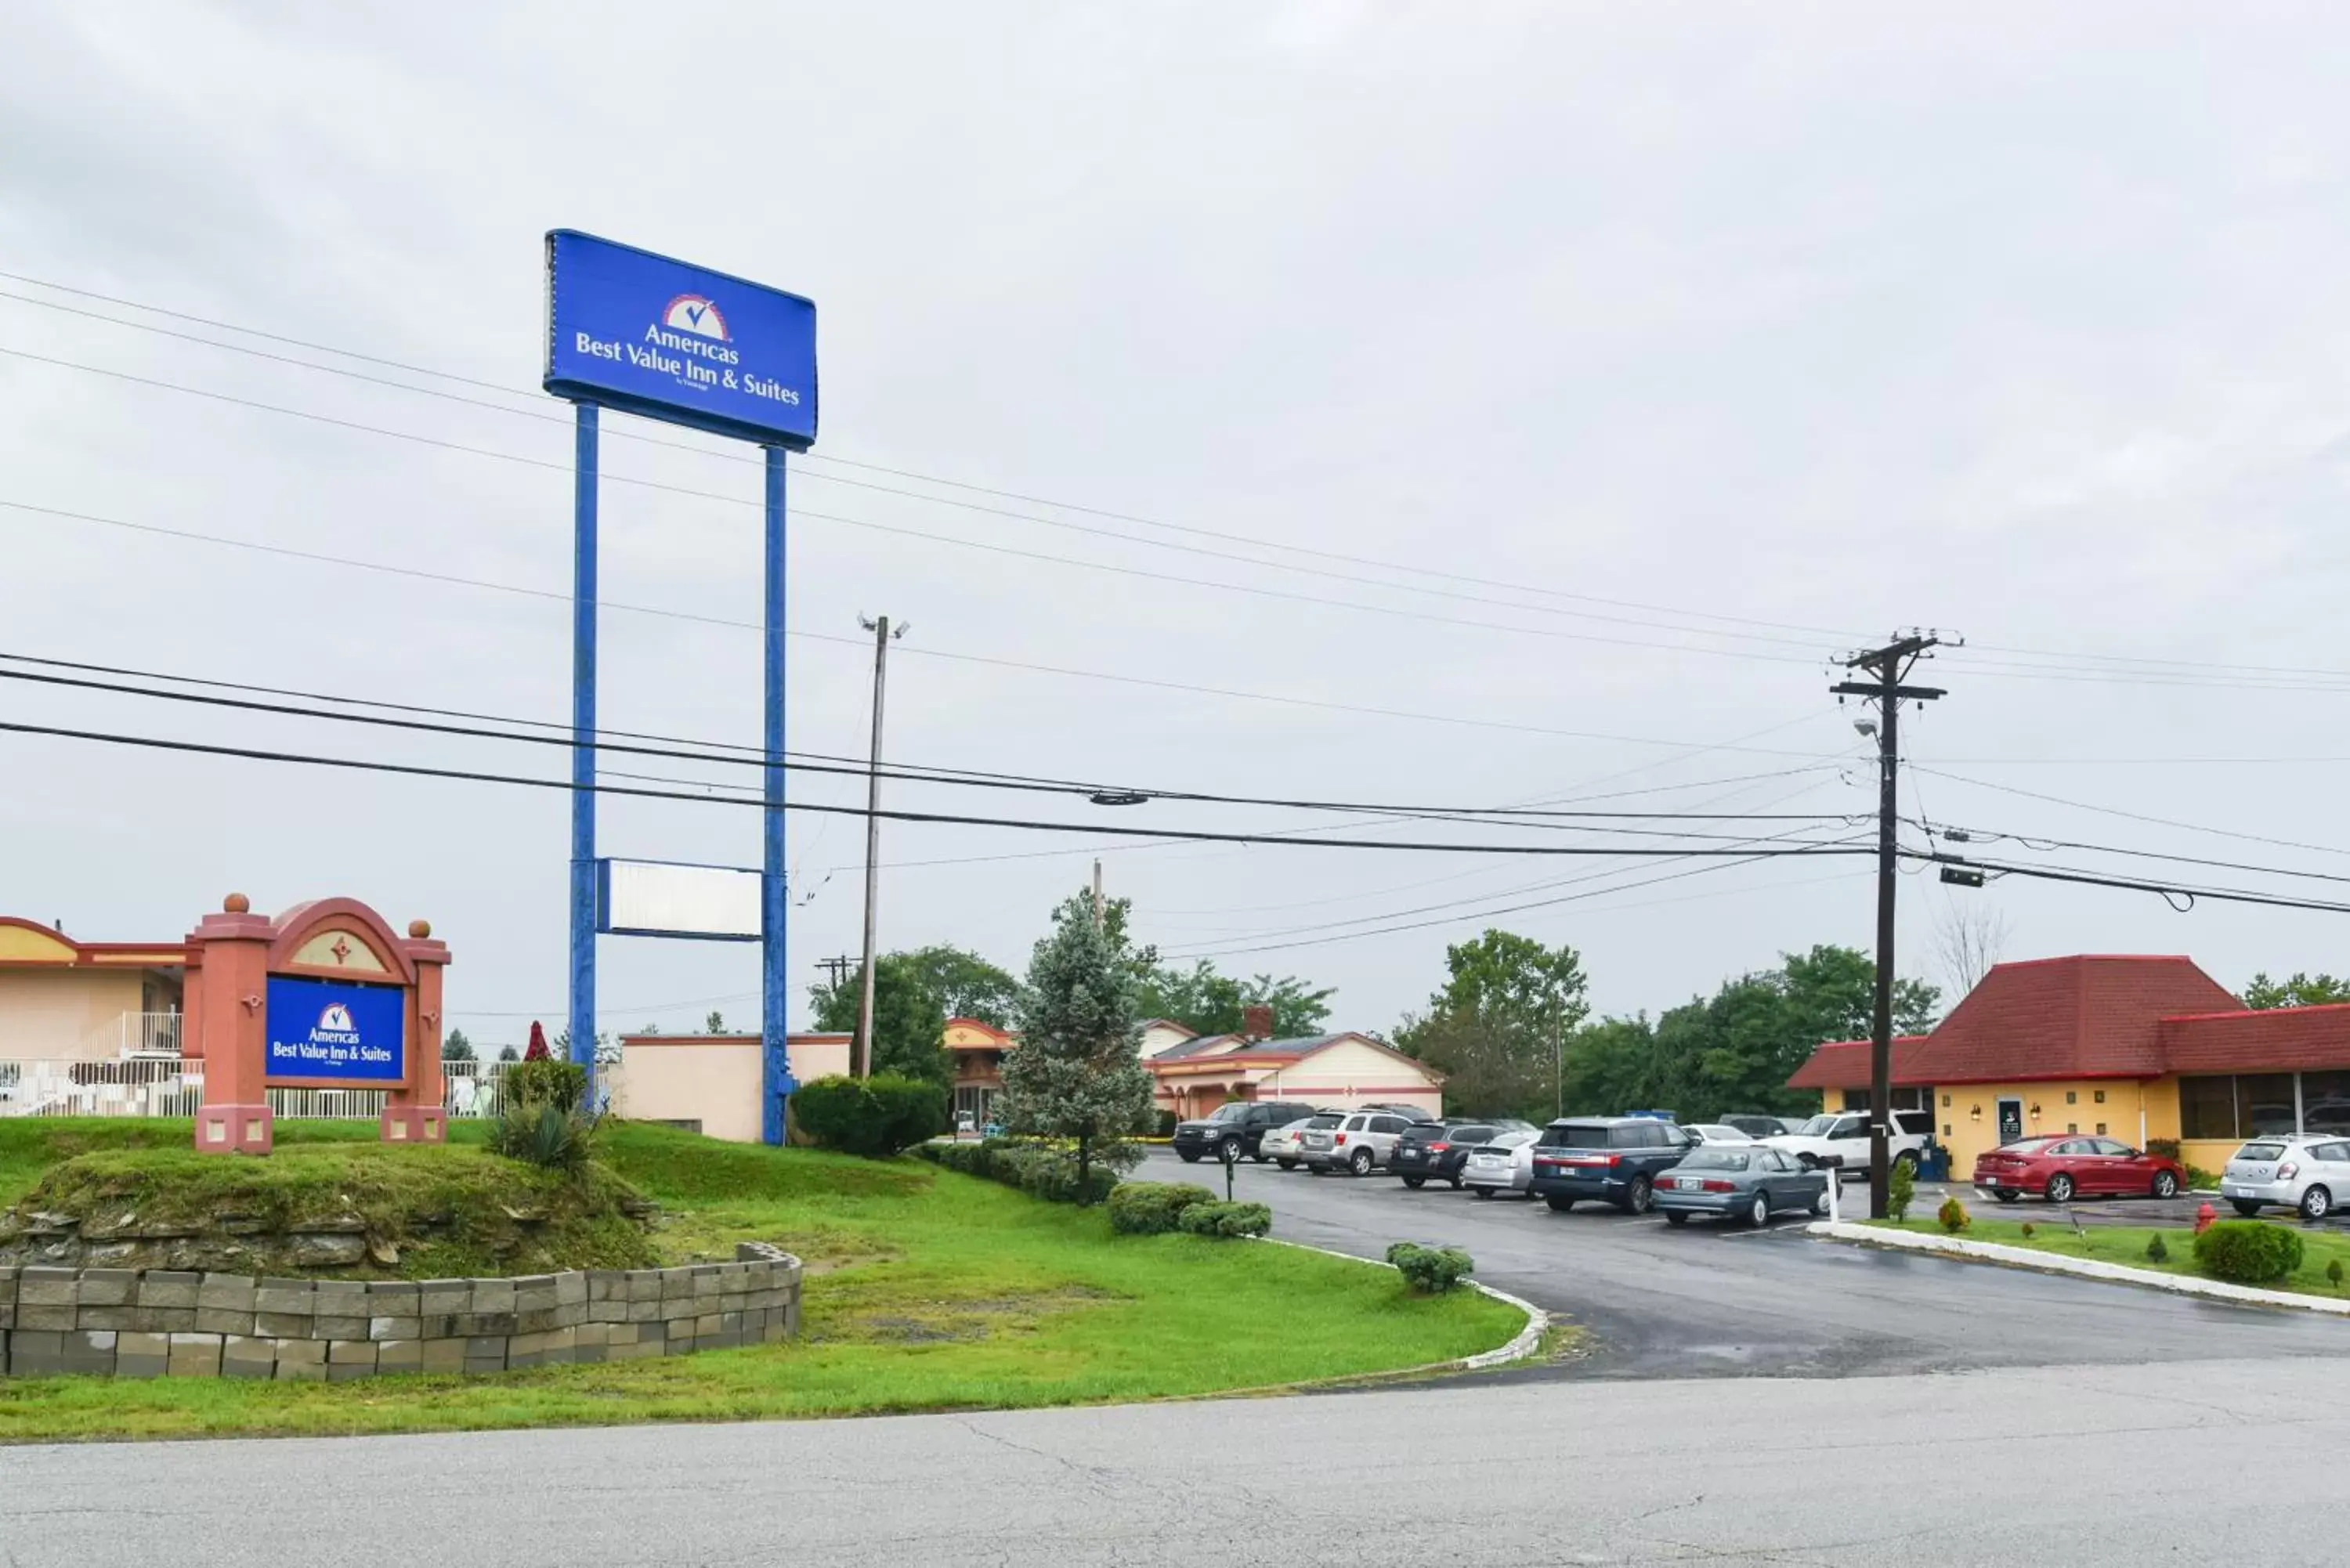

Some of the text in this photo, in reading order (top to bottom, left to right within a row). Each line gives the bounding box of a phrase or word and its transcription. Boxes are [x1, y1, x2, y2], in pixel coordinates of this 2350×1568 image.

[645, 323, 739, 365] Americas
[576, 331, 623, 362] Best
[627, 343, 682, 376] Value
[686, 358, 718, 385] Inn
[721, 368, 739, 390] &
[743, 373, 800, 406] Suites
[273, 1041, 392, 1062] Best Value Inn & Suites
[308, 1027, 360, 1045] Americas
